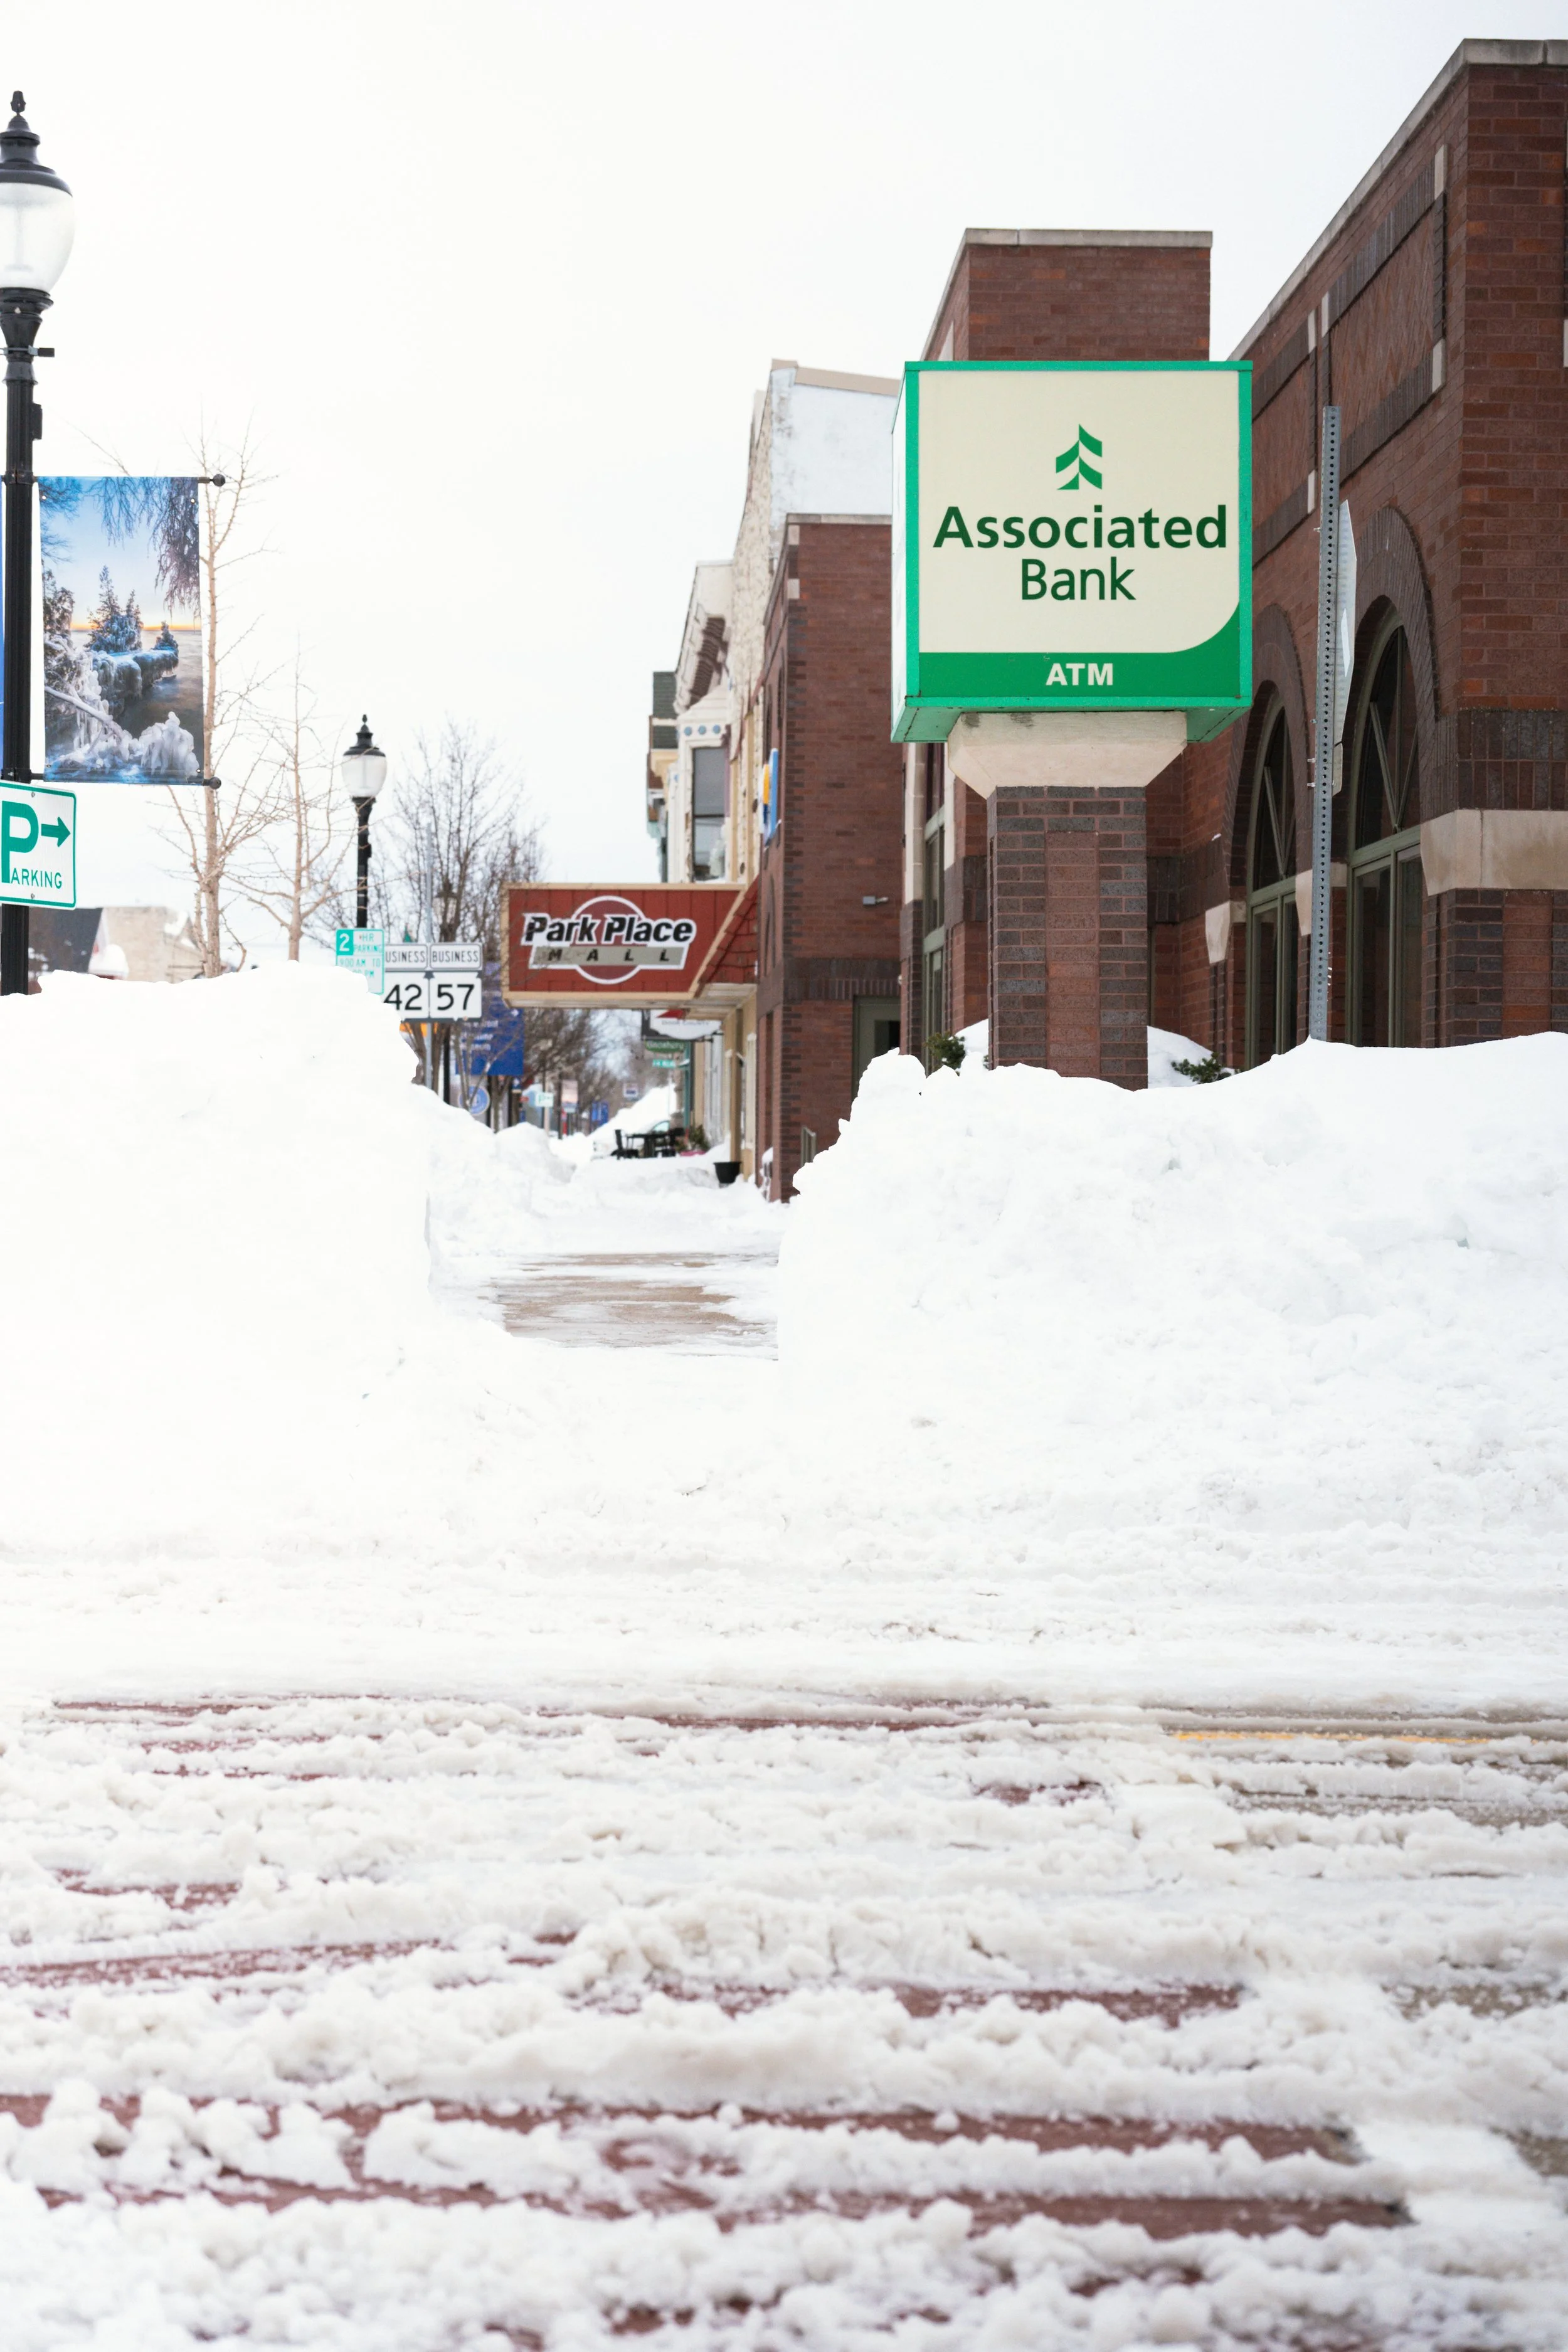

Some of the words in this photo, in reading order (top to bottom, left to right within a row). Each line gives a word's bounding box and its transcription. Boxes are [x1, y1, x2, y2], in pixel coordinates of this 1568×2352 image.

[933, 504, 1227, 549] Associated
[1021, 556, 1136, 601] Bank
[1046, 663, 1114, 686] ATM
[525, 917, 596, 942] Park
[604, 917, 693, 942] Place
[339, 933, 350, 951] 2
[362, 933, 374, 941] HR
[354, 945, 383, 953] PARKING
[373, 958, 381, 967] TO
[385, 950, 426, 963] USINESS
[432, 950, 479, 963] BUSINESS
[548, 949, 669, 961] MALL
[384, 984, 422, 1010] 42
[437, 984, 475, 1010] 57
